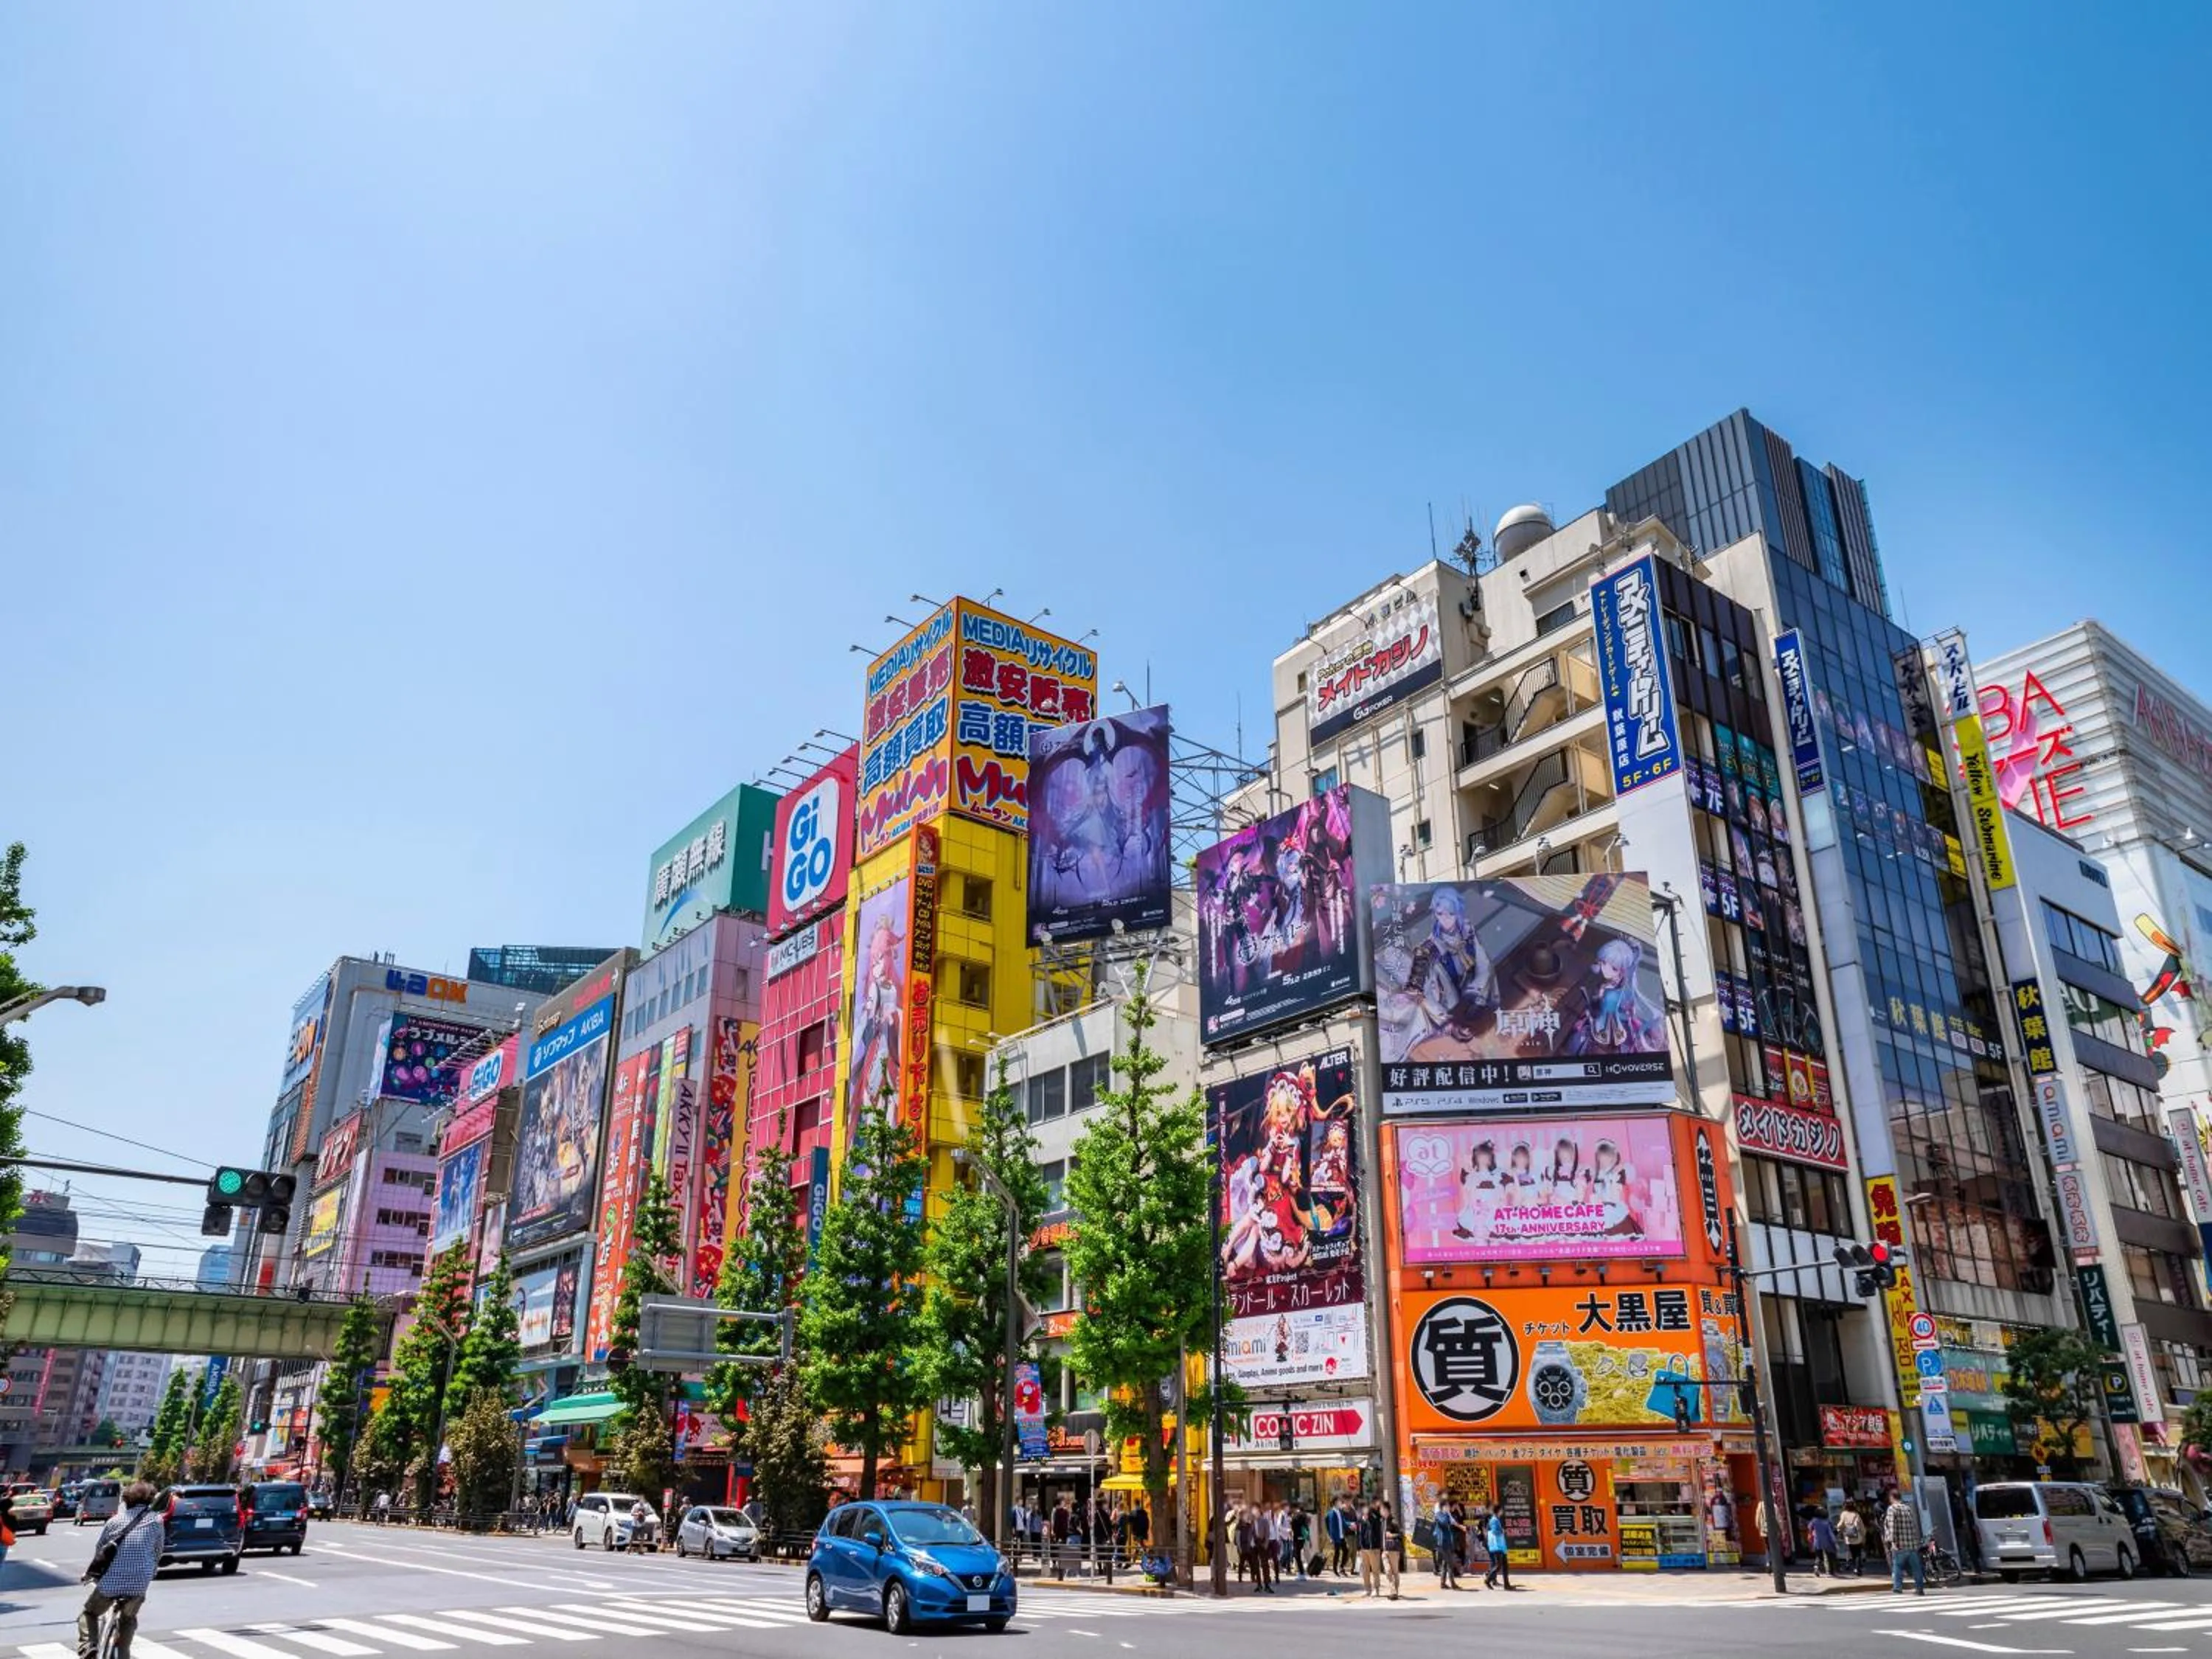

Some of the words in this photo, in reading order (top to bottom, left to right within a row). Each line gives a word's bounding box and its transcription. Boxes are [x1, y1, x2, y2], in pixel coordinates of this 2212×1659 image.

[962, 611, 1095, 680] MEDIAリサイクル
[1318, 625, 1428, 712] メイドカジノ
[961, 647, 1093, 724] 激安販売
[1976, 669, 2065, 742] BA
[958, 700, 1055, 759] 高額
[956, 754, 1031, 810] Mu
[1965, 752, 1983, 796] Yellow
[1012, 816, 1030, 829] AK
[1977, 807, 2003, 881] Submarine
[1493, 993, 1561, 1050] 原神
[2016, 986, 2053, 1073] 秋葉館
[1319, 1051, 1349, 1070] ALTER
[678, 1084, 694, 1142] AKKY
[1738, 1101, 1840, 1164] メイドカジノ
[2042, 1085, 2070, 1161] amiami
[669, 1160, 688, 1212] Tax-f
[1563, 1204, 1605, 1218] CAFE
[1520, 1221, 1605, 1234] ANNIVERSARY
[1524, 1322, 1571, 1337] チケット
[1576, 1289, 1691, 1334] 大黒屋
[1700, 1289, 1737, 1315] 質&買
[1916, 1320, 1931, 1333] 40
[1227, 1336, 1267, 1357] miami
[1891, 1298, 1913, 1367] 세점
[1425, 1315, 1510, 1407] 質
[1256, 1415, 1309, 1437] COIC
[1312, 1413, 1335, 1435] ZIN
[1561, 1464, 1593, 1497] 質
[1551, 1505, 1609, 1536] 買取
